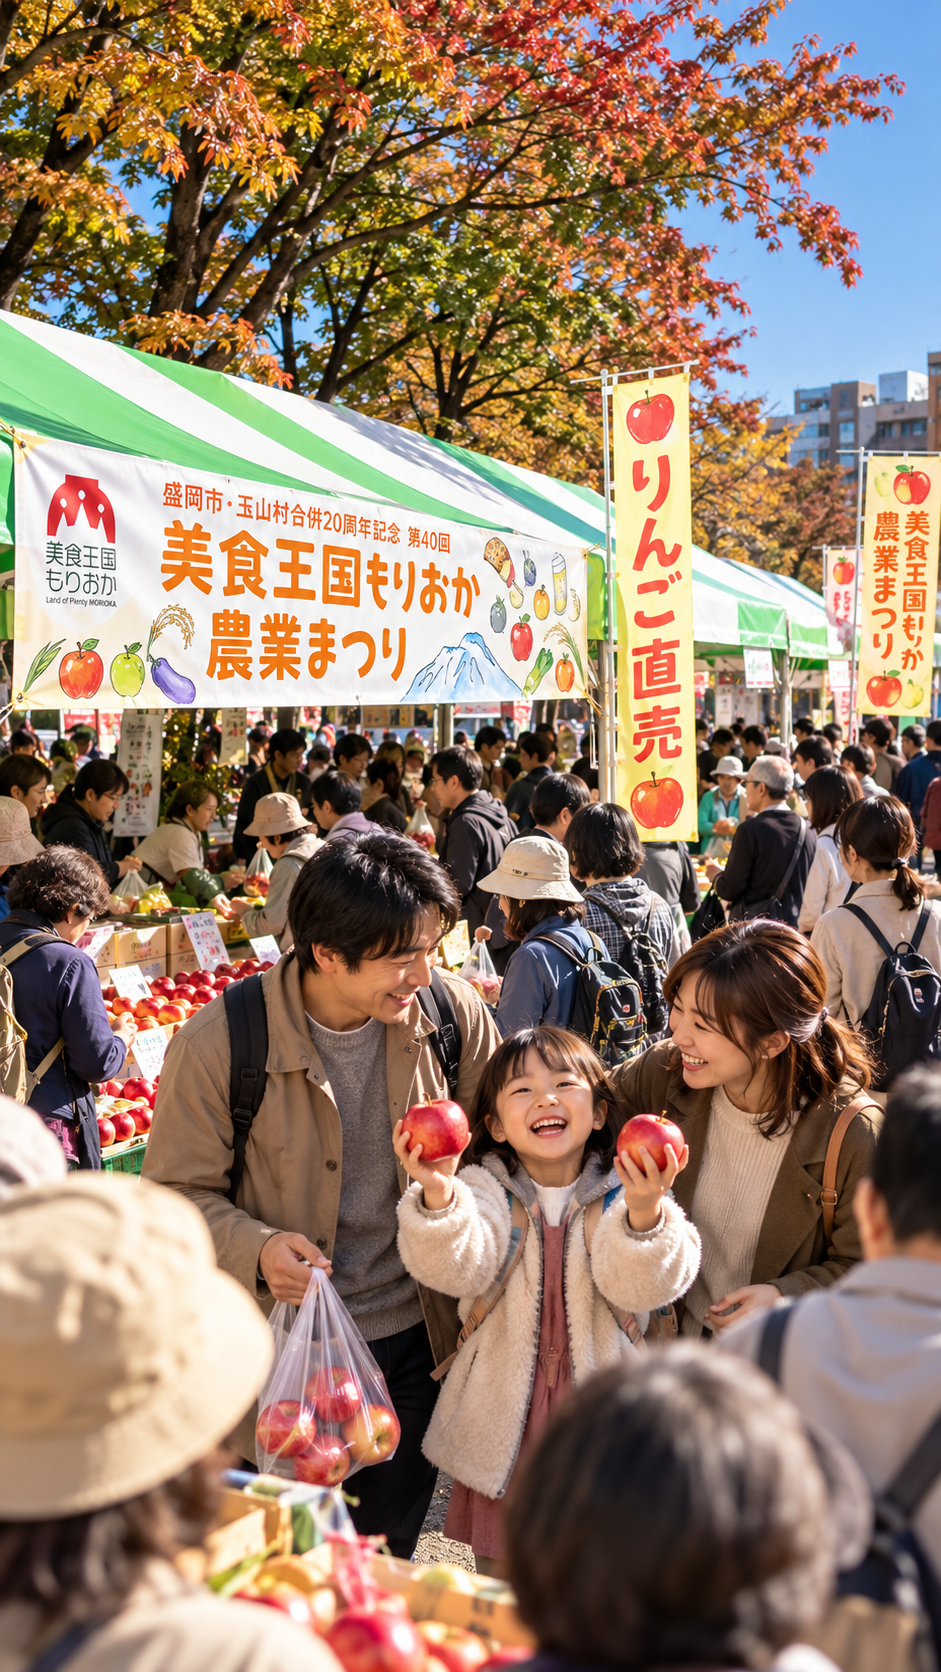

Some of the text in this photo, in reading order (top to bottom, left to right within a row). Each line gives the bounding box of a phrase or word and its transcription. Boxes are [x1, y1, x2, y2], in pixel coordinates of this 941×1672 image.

[163, 481, 450, 553] 盛岡市・玉山村合併20周年記念 第40回
[46, 541, 116, 571] 美食王国
[46, 568, 117, 596] もりおか
[161, 519, 482, 619] 美食王国もりおか
[871, 511, 900, 660] 農業まつり
[46, 596, 61, 605] Land
[62, 597, 69, 605] of
[89, 599, 117, 608] MORIOKA
[632, 454, 683, 763] りんご直売
[206, 609, 407, 682] 農業まつり
